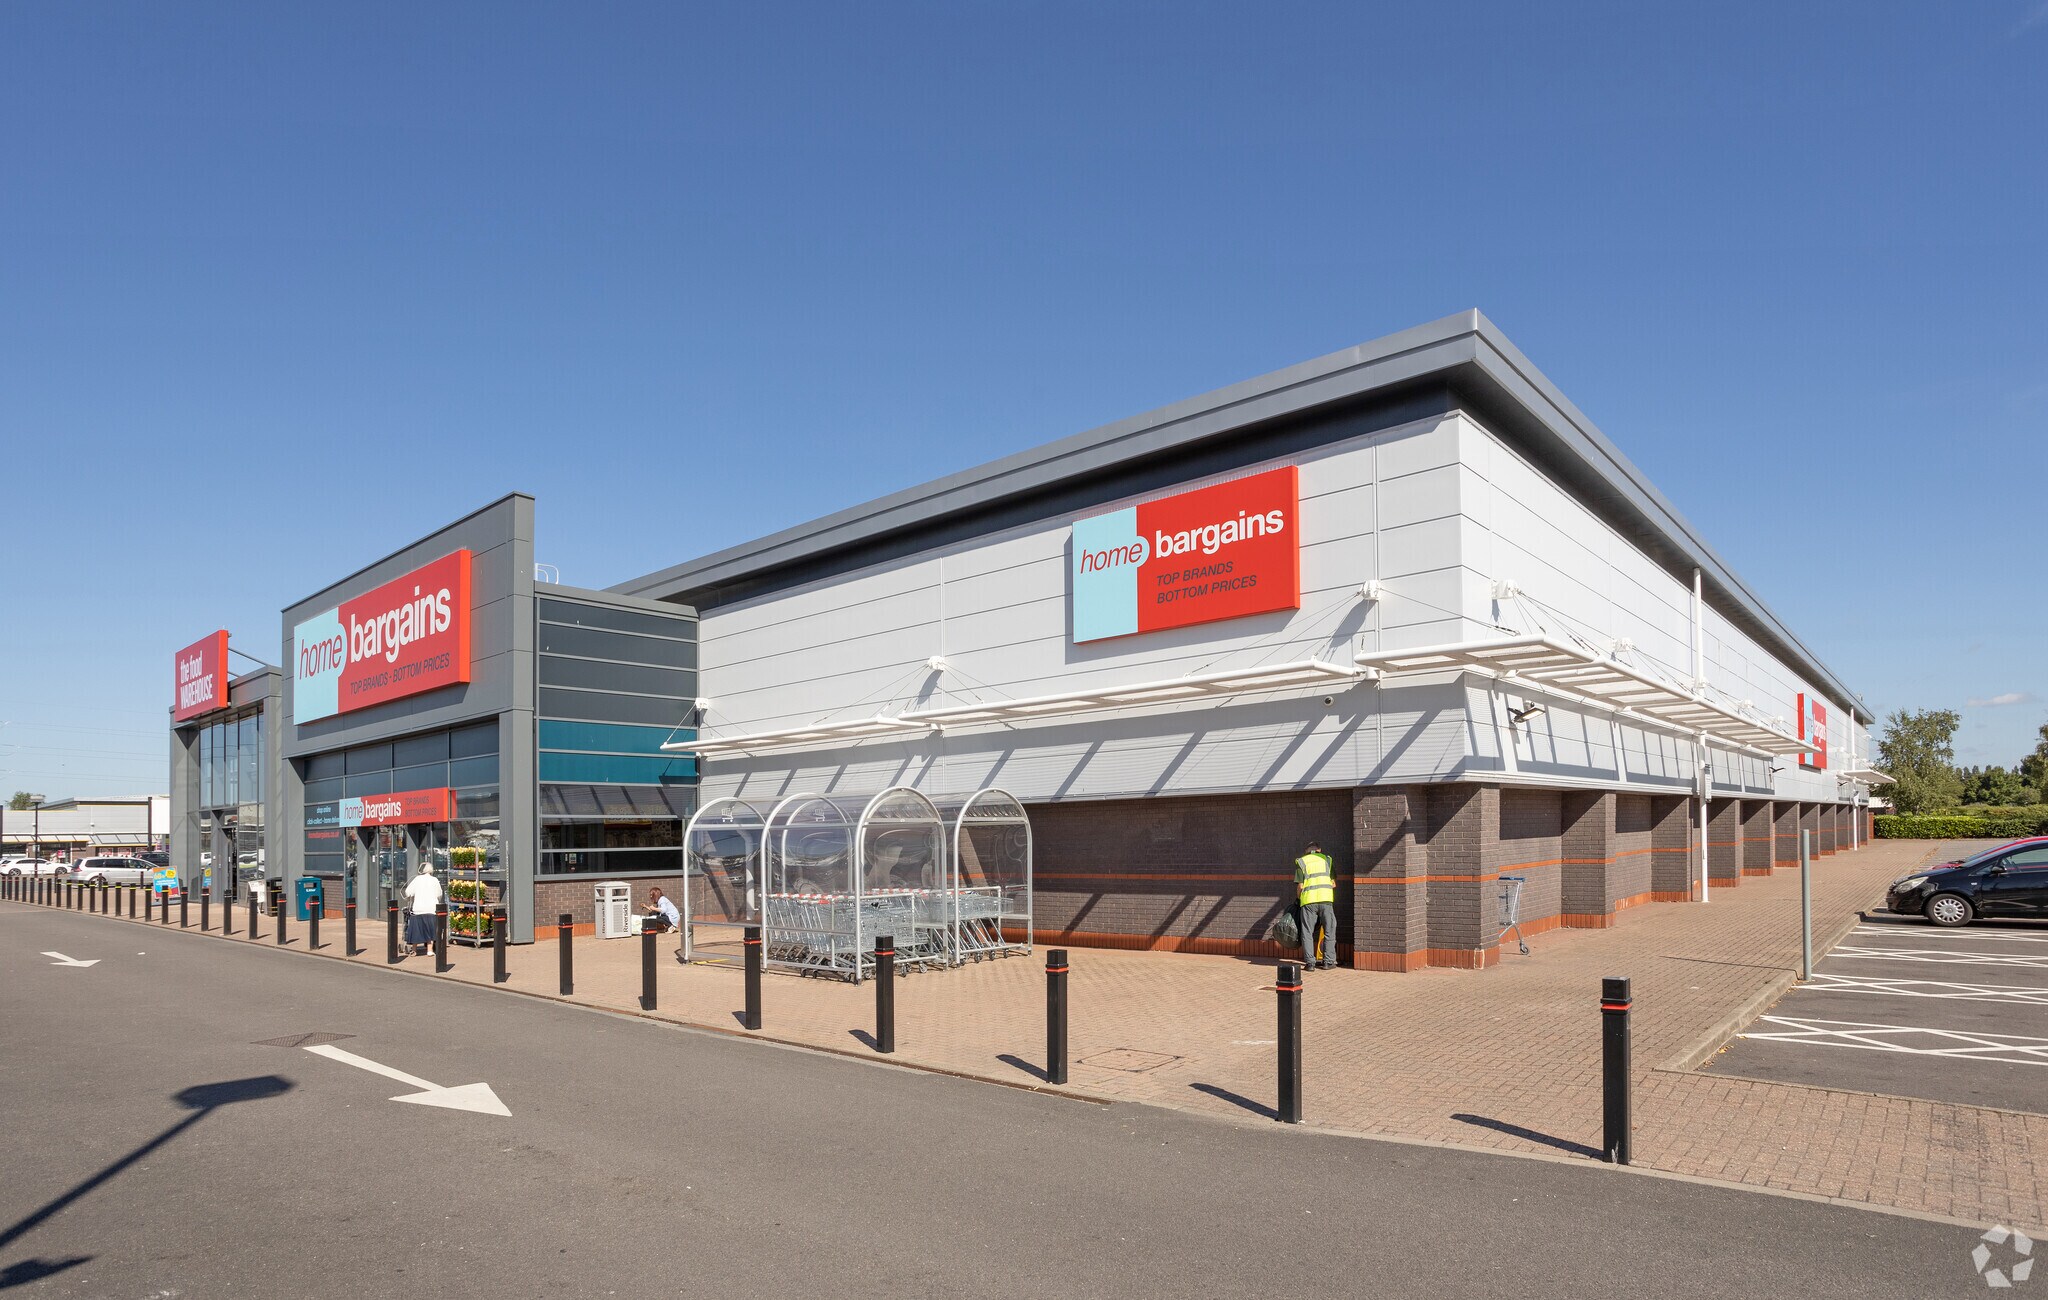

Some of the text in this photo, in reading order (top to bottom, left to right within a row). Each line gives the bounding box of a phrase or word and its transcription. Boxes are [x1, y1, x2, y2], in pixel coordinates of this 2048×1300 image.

[1080, 509, 1284, 574] home bargains
[1156, 561, 1234, 587] TOP BRANDS
[1157, 574, 1257, 604] BOTTOM PRICES
[299, 585, 451, 680] home bargains
[181, 673, 213, 710] WAREHOUSE
[350, 682, 363, 695] TOP
[363, 671, 388, 692] BRANDS
[393, 661, 422, 682] BOTTOM
[423, 652, 450, 673] PRICES
[344, 798, 401, 822] home bargains
